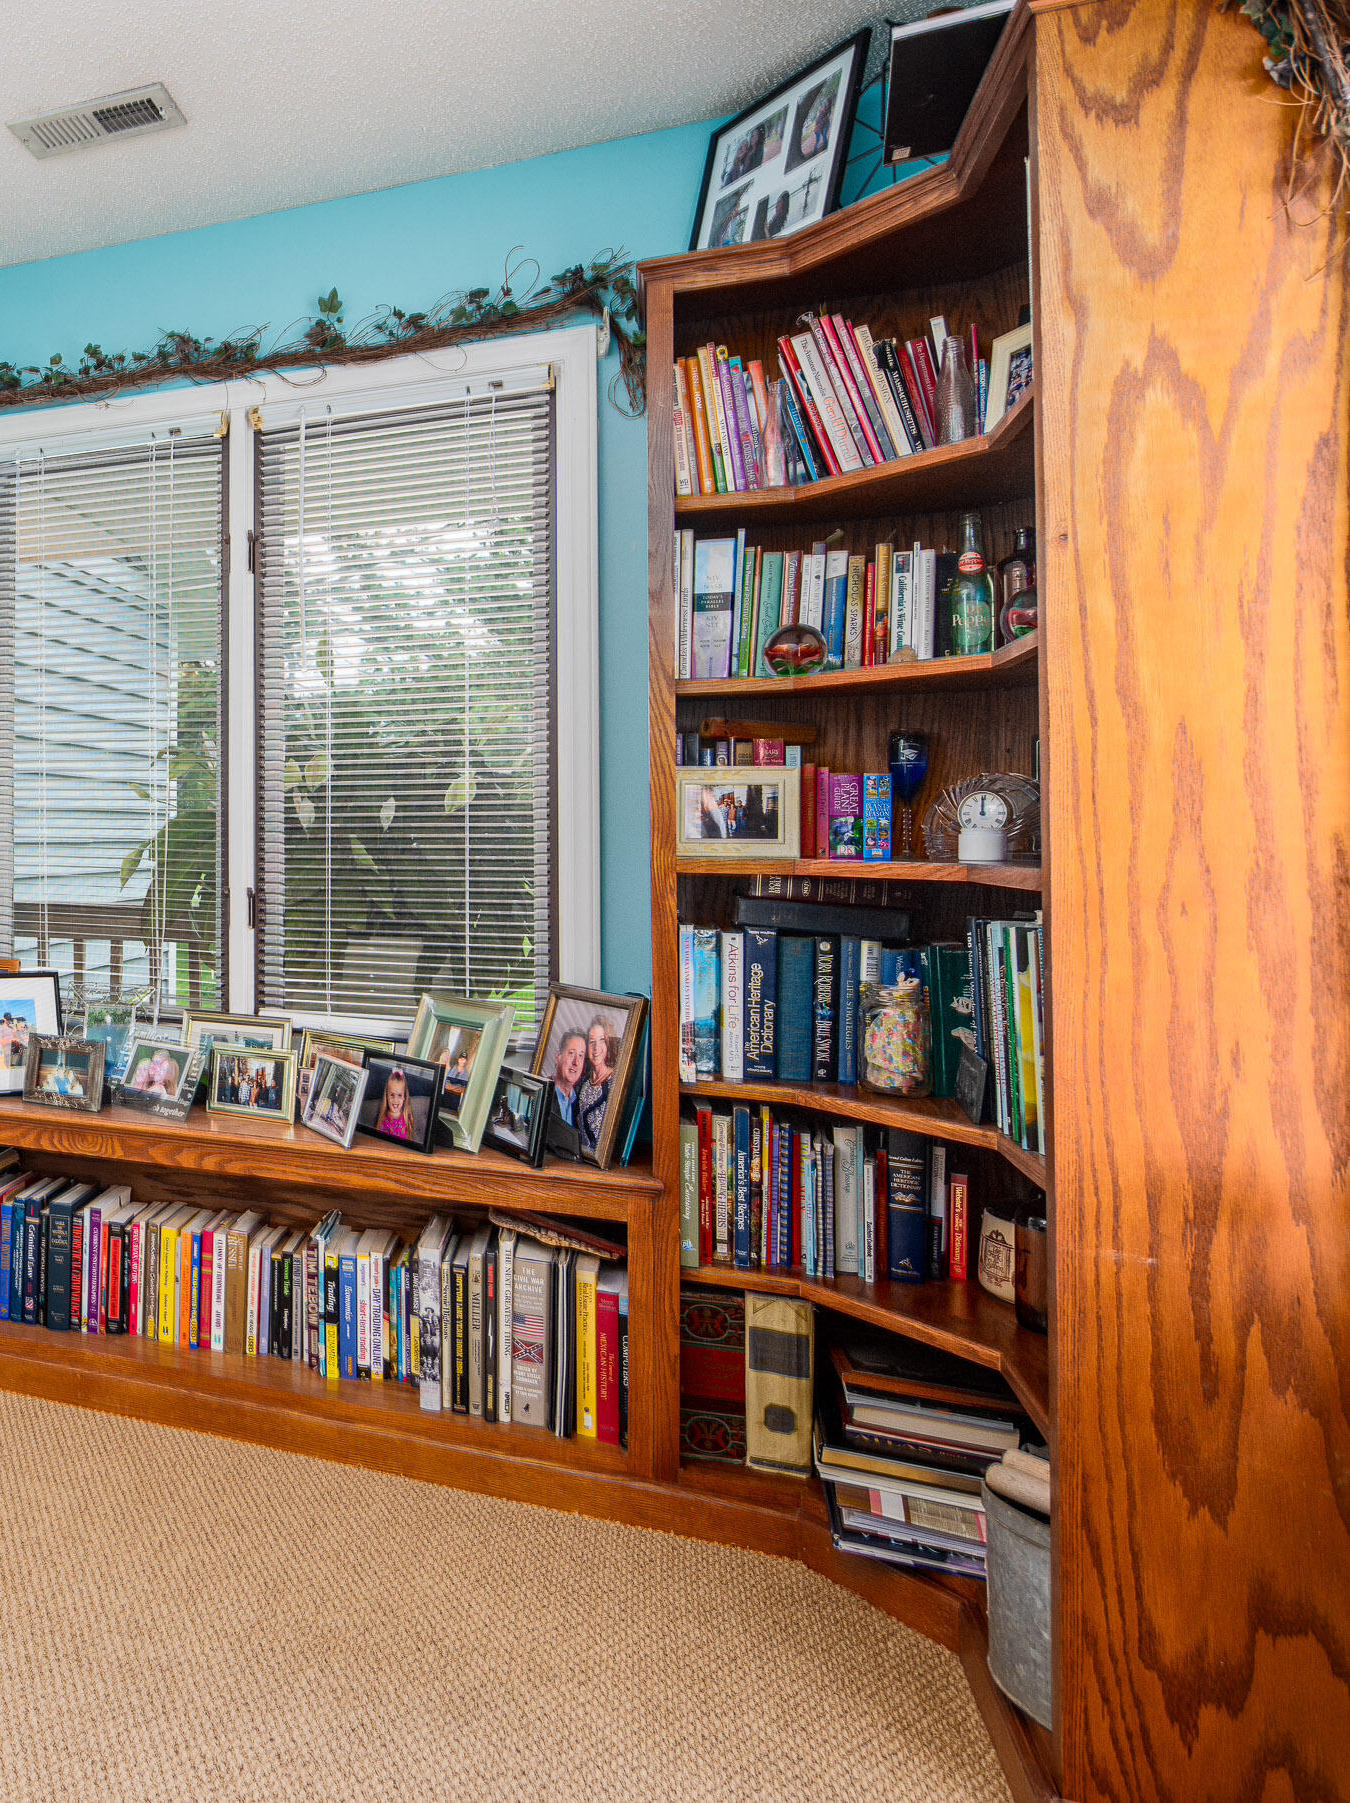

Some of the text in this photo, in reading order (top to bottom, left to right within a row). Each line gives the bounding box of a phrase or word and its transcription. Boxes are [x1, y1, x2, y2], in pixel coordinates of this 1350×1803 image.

[805, 350, 815, 371] Amateur
[919, 354, 930, 384] Department
[876, 372, 891, 404] DESIGN
[892, 371, 917, 435] MASSACHUSETTS
[824, 396, 858, 464] Gerald Durrell
[850, 565, 860, 636] NICHOLAS SPARKS
[897, 575, 907, 630] California's Wine
[841, 783, 850, 814] PLANT
[850, 782, 858, 814] GREAT
[728, 944, 739, 1029] Atkins for Life
[814, 954, 834, 1003] NORA ROBERTS
[846, 980, 854, 999] LIFE
[746, 963, 764, 1062] American Heritage
[761, 1000, 776, 1054] Dictionary
[816, 1020, 832, 1063] BLUE SMOKE
[717, 1170, 727, 1200] HEALING
[735, 1150, 748, 1230] America's Best Recipes
[891, 1182, 921, 1190] DICTIONARY
[717, 1201, 727, 1227] HERBS
[228, 1235, 238, 1270] RUSSIA
[954, 1232, 962, 1260] Dictionary
[307, 1249, 318, 1276] TIM
[522, 1267, 536, 1275] THE
[455, 1274, 463, 1302] BOTTOM
[514, 1275, 544, 1285] CIVIL WAR
[514, 1283, 543, 1294] ARCHIVE
[308, 1278, 318, 1325] TEBOW
[359, 1300, 367, 1334] short-term
[455, 1303, 463, 1319] LINE
[471, 1292, 481, 1330] MILLER
[503, 1248, 512, 1356] THE NEXT GREATEST THING
[372, 1288, 381, 1366] DAY TRADING ONLINE
[359, 1337, 367, 1360] trading
